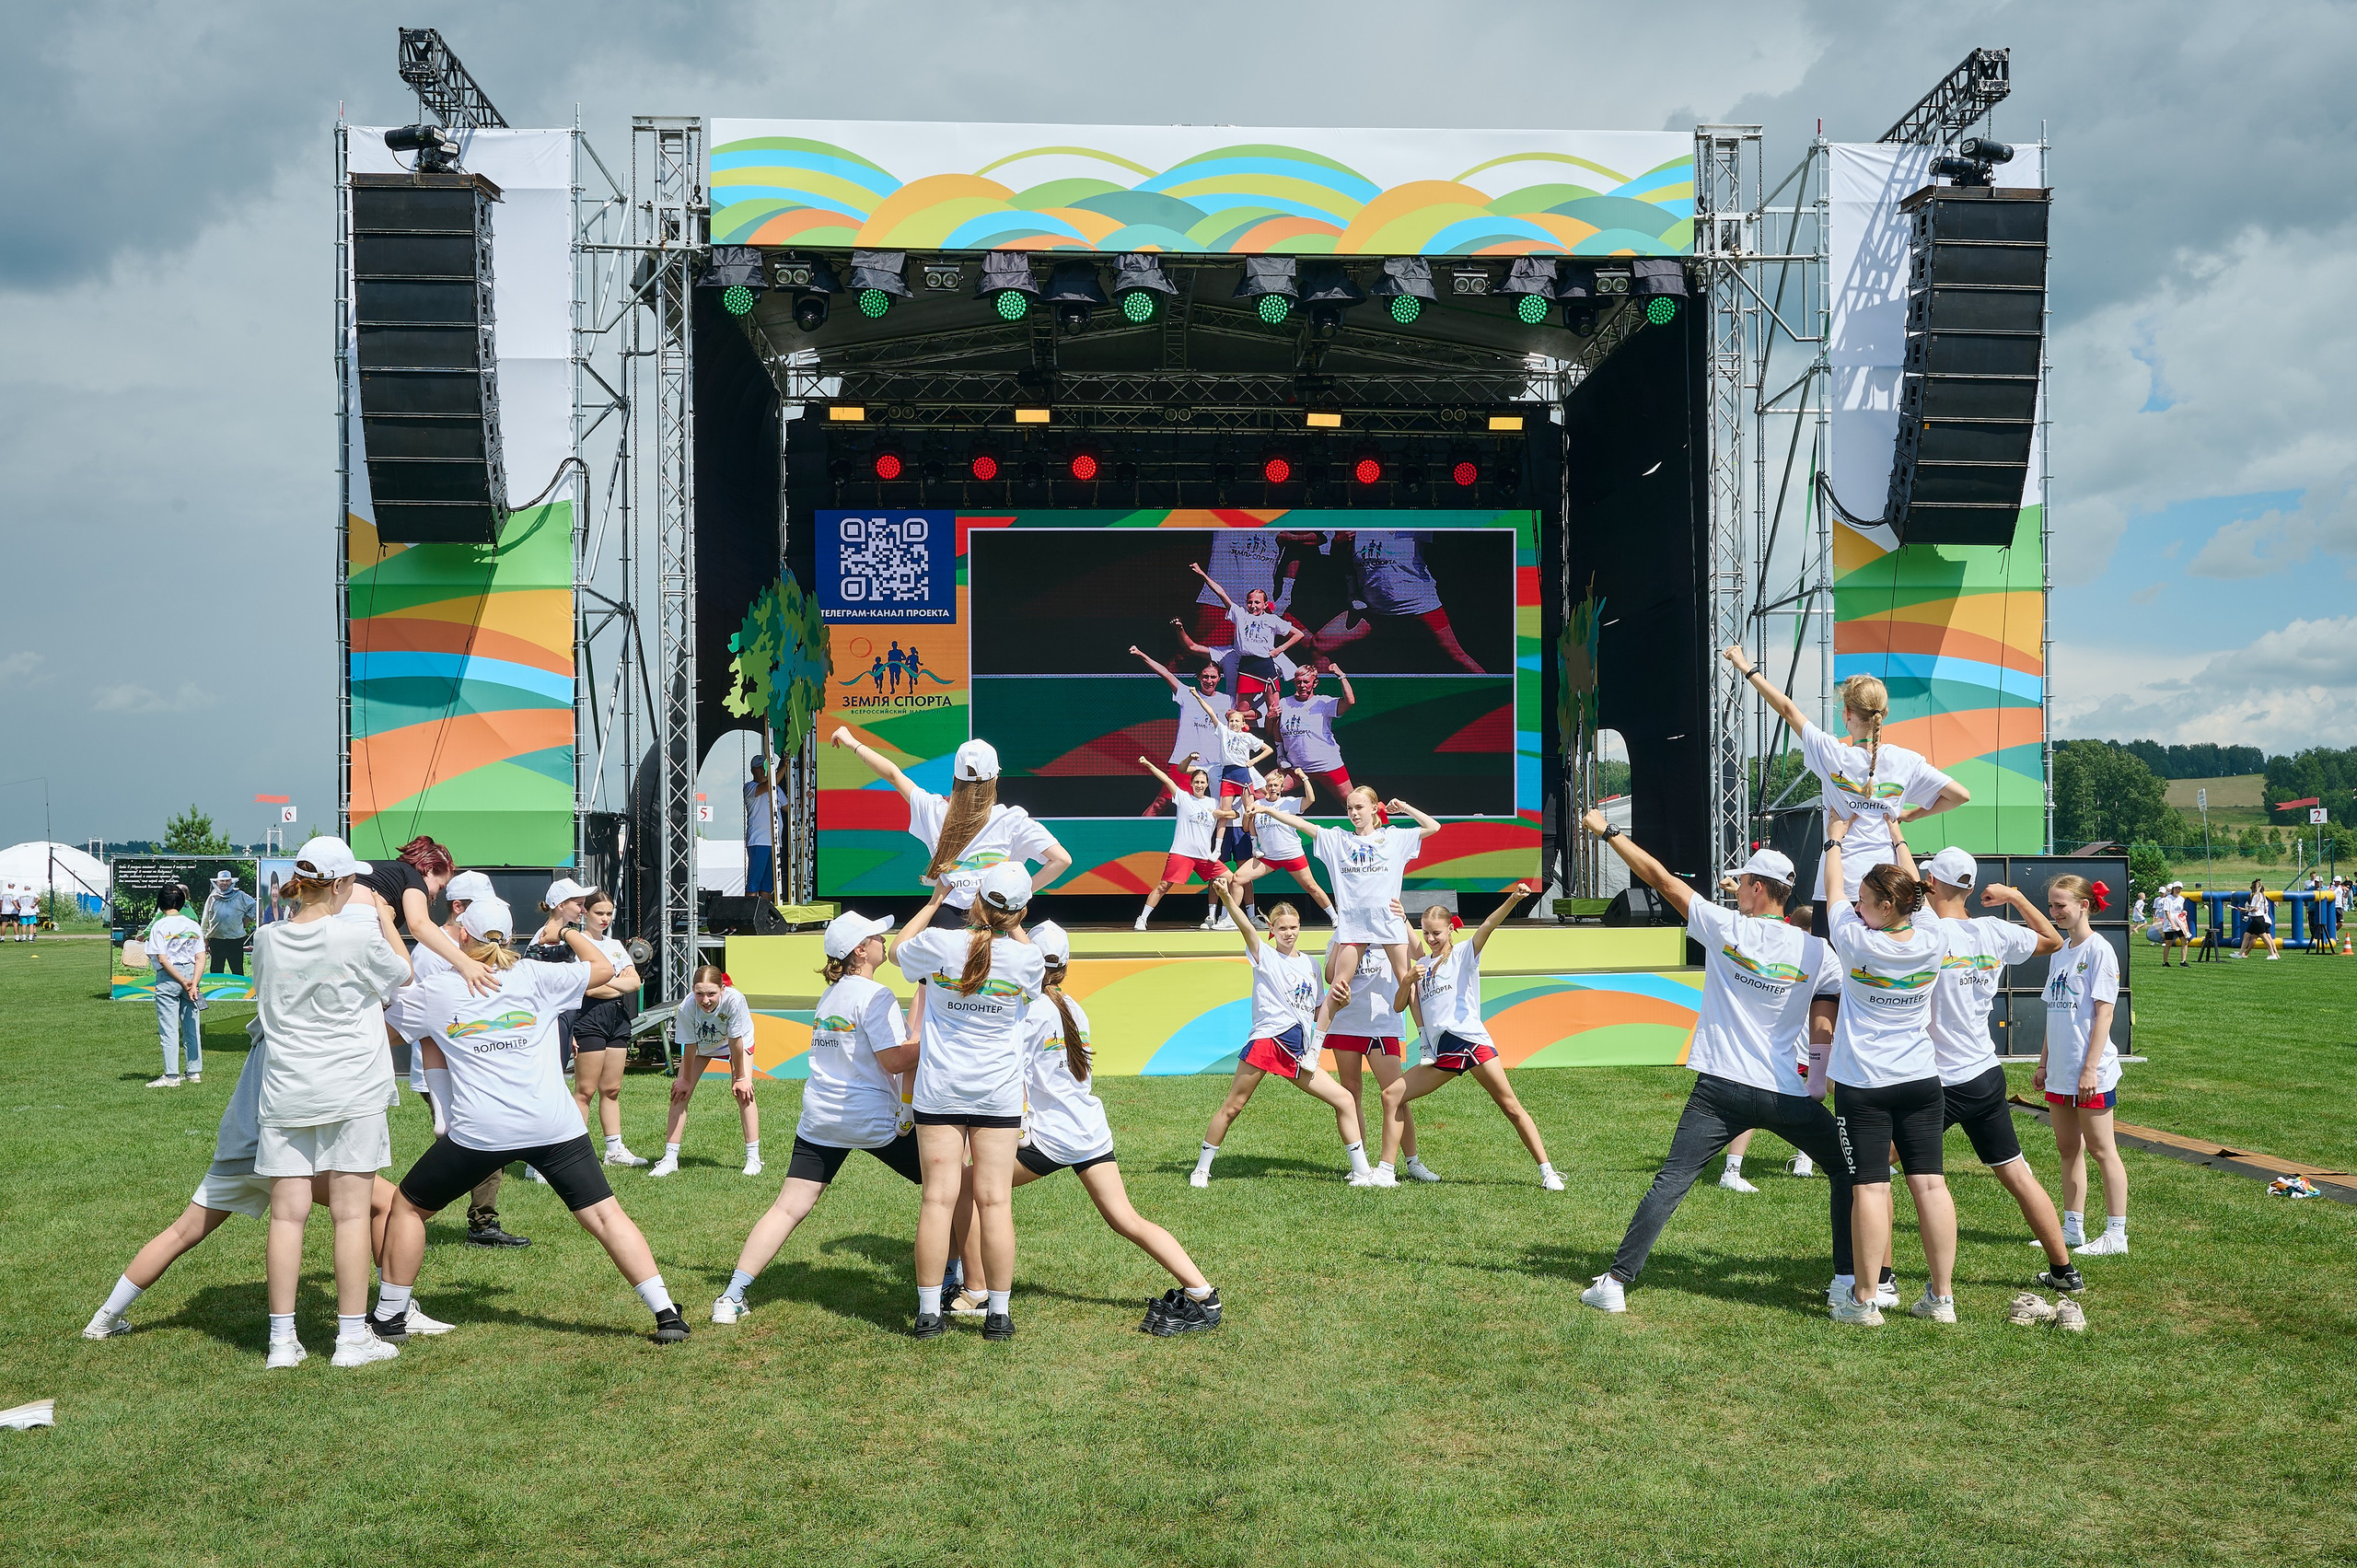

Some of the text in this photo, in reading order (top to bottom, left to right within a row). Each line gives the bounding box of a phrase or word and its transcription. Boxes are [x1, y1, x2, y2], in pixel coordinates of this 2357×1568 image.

[820, 609, 950, 618] ТЕЛЕГРАМ-КАНАЛ ПРОЕКТА
[842, 695, 953, 707] ЗЕМЛЯ СПОРТА
[284, 807, 292, 821] 6
[700, 807, 708, 820] 5
[2313, 809, 2321, 822] 2
[1734, 972, 1786, 995] ВОЛОНТЁР
[1869, 994, 1924, 1005] ВОЛОНТЁР
[947, 1001, 1003, 1014] ВОЛОНТЁР
[473, 1037, 528, 1054] ВОЛОНТЁР
[1836, 1116, 1857, 1175] Reebok
